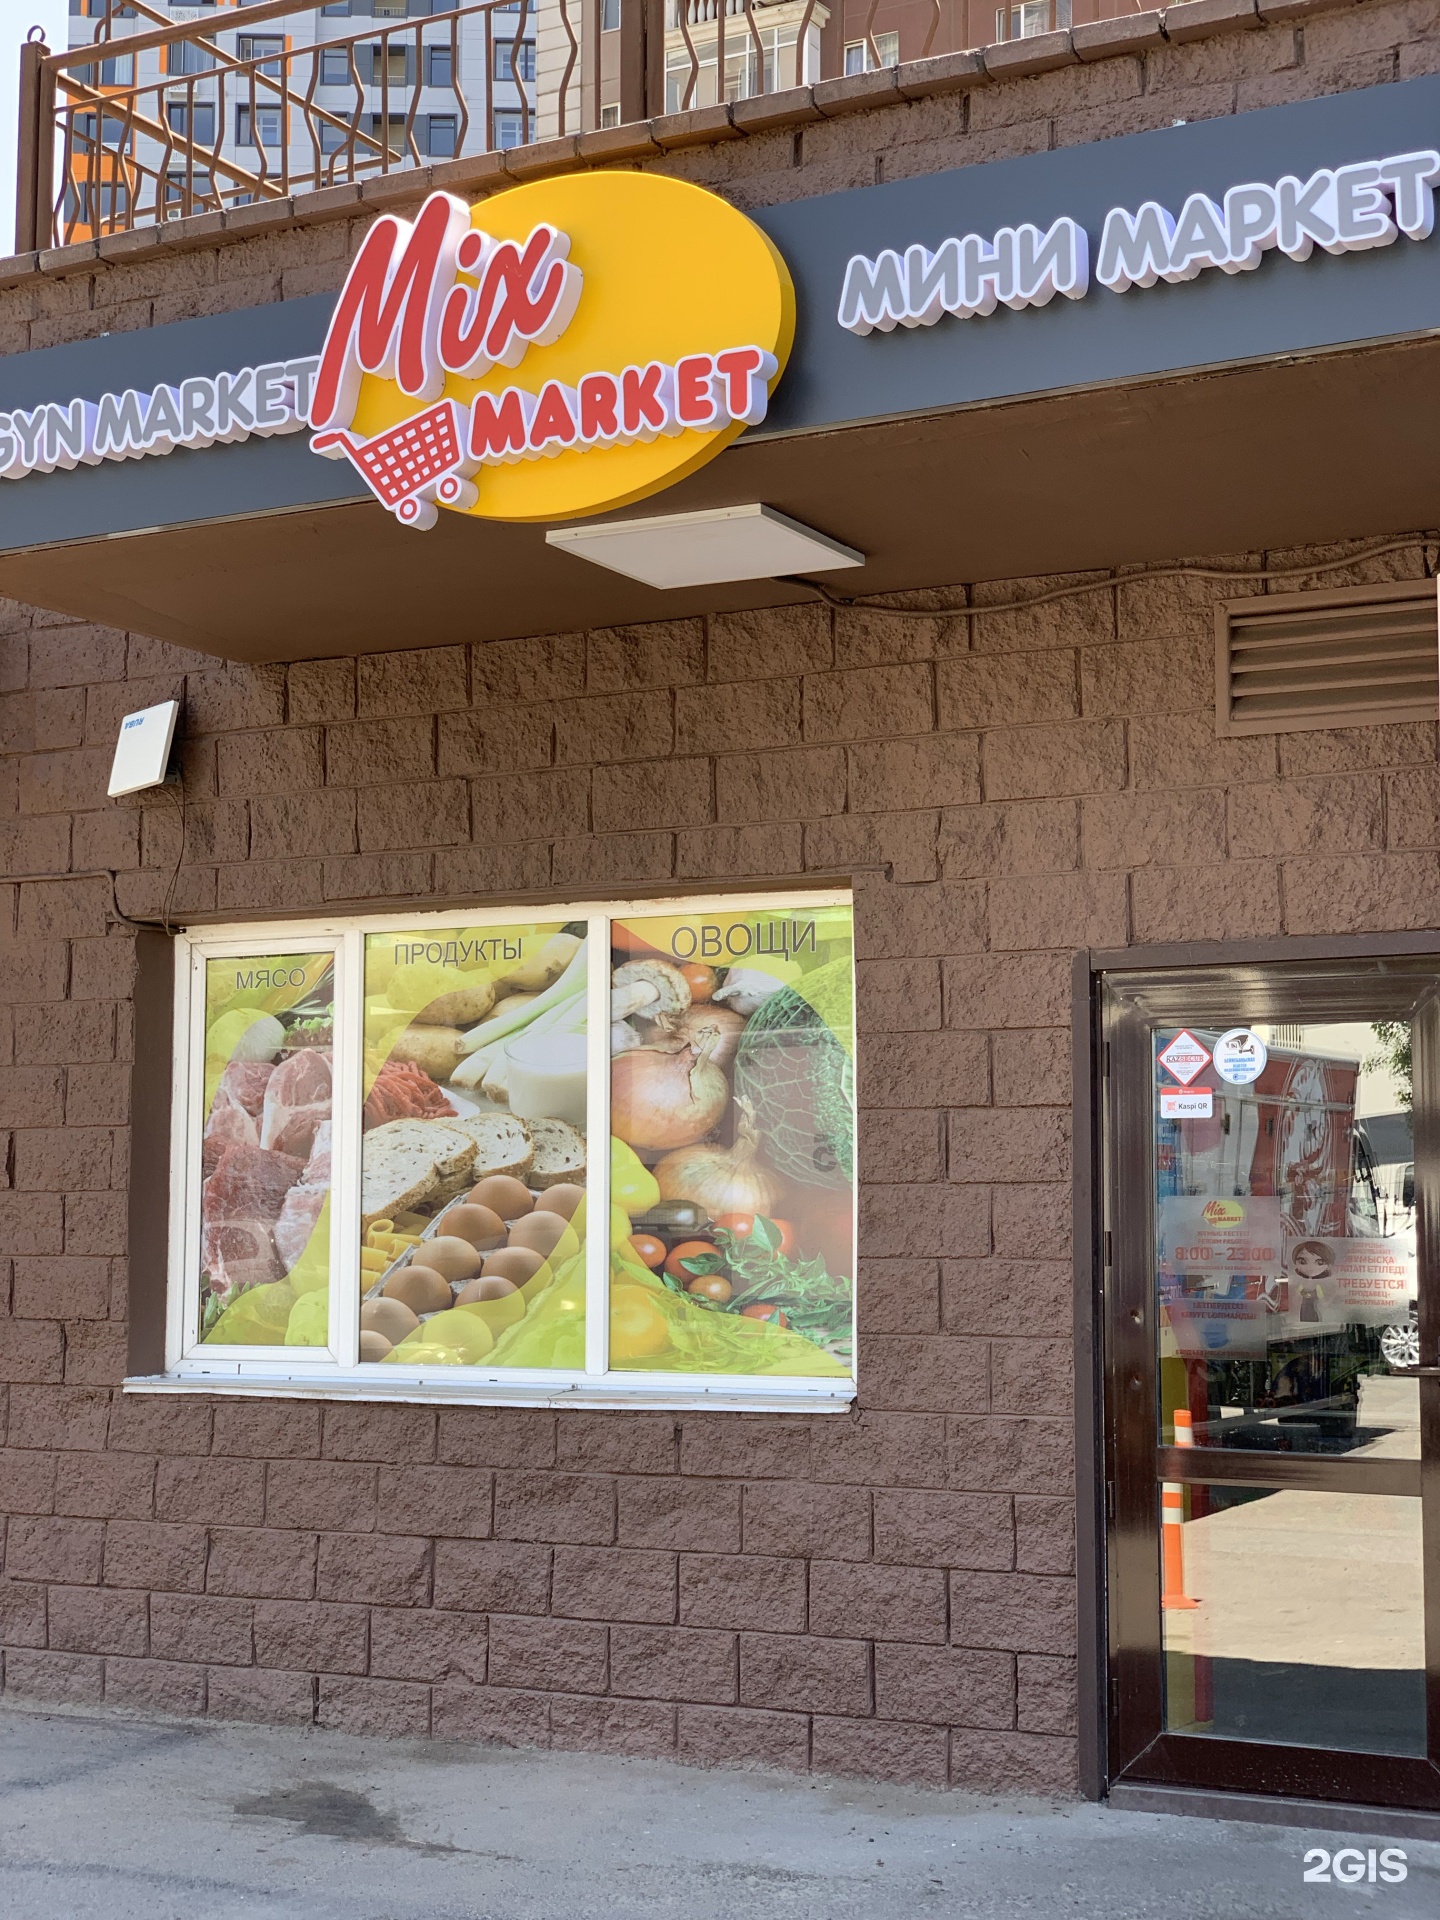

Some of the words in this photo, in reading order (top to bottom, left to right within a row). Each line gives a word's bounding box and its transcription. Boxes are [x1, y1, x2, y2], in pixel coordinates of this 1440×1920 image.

[838, 216, 1076, 330] МИНИ
[1096, 149, 1440, 286] МАРКЕТ
[309, 191, 568, 431] Mix
[93, 355, 320, 456] MARKET
[467, 345, 764, 461] MARKET
[394, 938, 522, 968] ПРОДУКТЫ
[671, 919, 817, 962] ОВОЩИ
[235, 967, 306, 991] МЯСО
[1178, 1102, 1197, 1111] Kaspi
[1197, 1102, 1208, 1110] QR
[1201, 1200, 1226, 1216] Mix
[1175, 1246, 1213, 1261] 8:00
[1226, 1246, 1275, 1261] 23:00
[1336, 1278, 1404, 1289] ТРЕБУЕТСЯ
